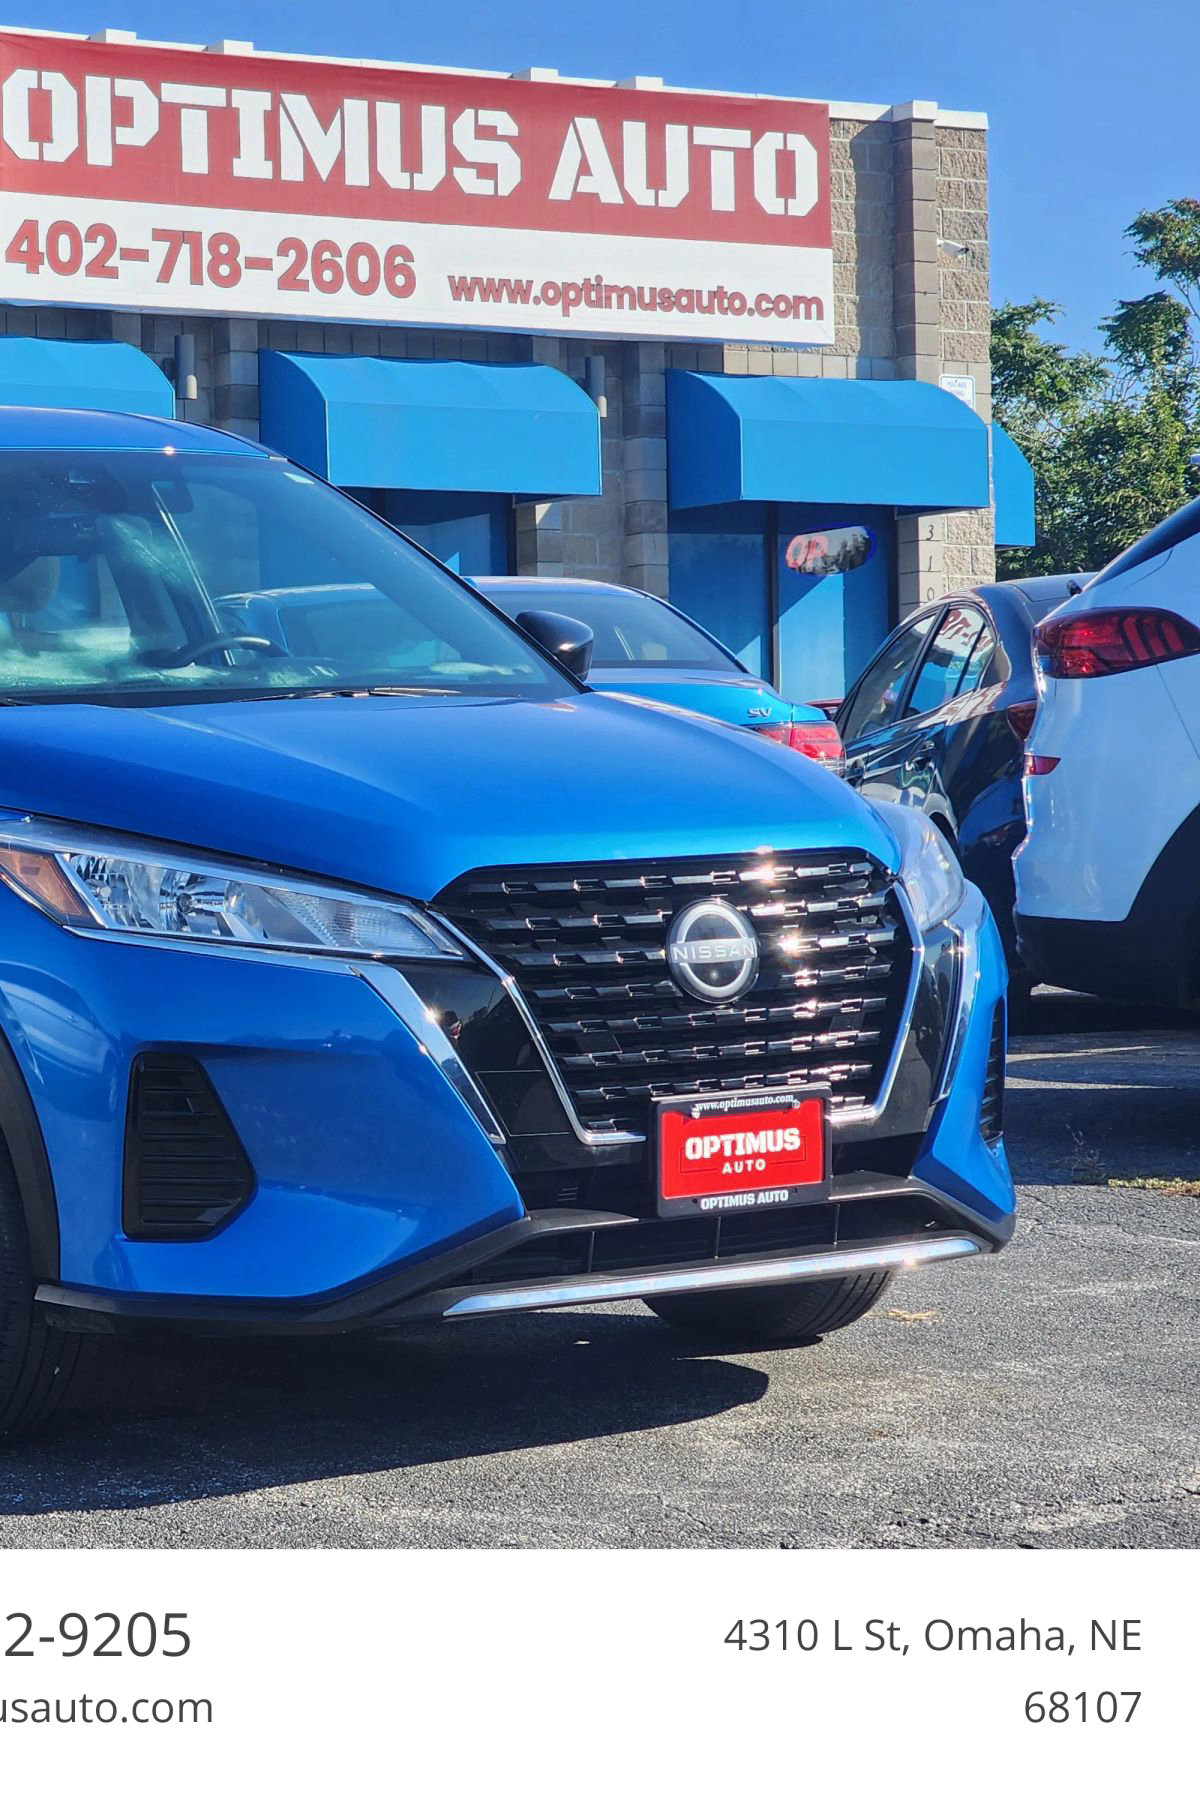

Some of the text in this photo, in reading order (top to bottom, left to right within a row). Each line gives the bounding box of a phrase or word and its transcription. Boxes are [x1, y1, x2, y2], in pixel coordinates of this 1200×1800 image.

[2, 67, 819, 217] OPTIMUS AUTO
[5, 219, 416, 298] 402-718-2606
[447, 273, 824, 322] www.optimusauto.com
[747, 708, 771, 719] SV
[672, 942, 755, 961] NISSAN
[696, 1094, 794, 1112] www.optimusauto.com
[685, 1127, 801, 1160] OPTIMUS
[722, 1158, 766, 1174] AUTO
[701, 1189, 789, 1210] OPTIMUS AUTO
